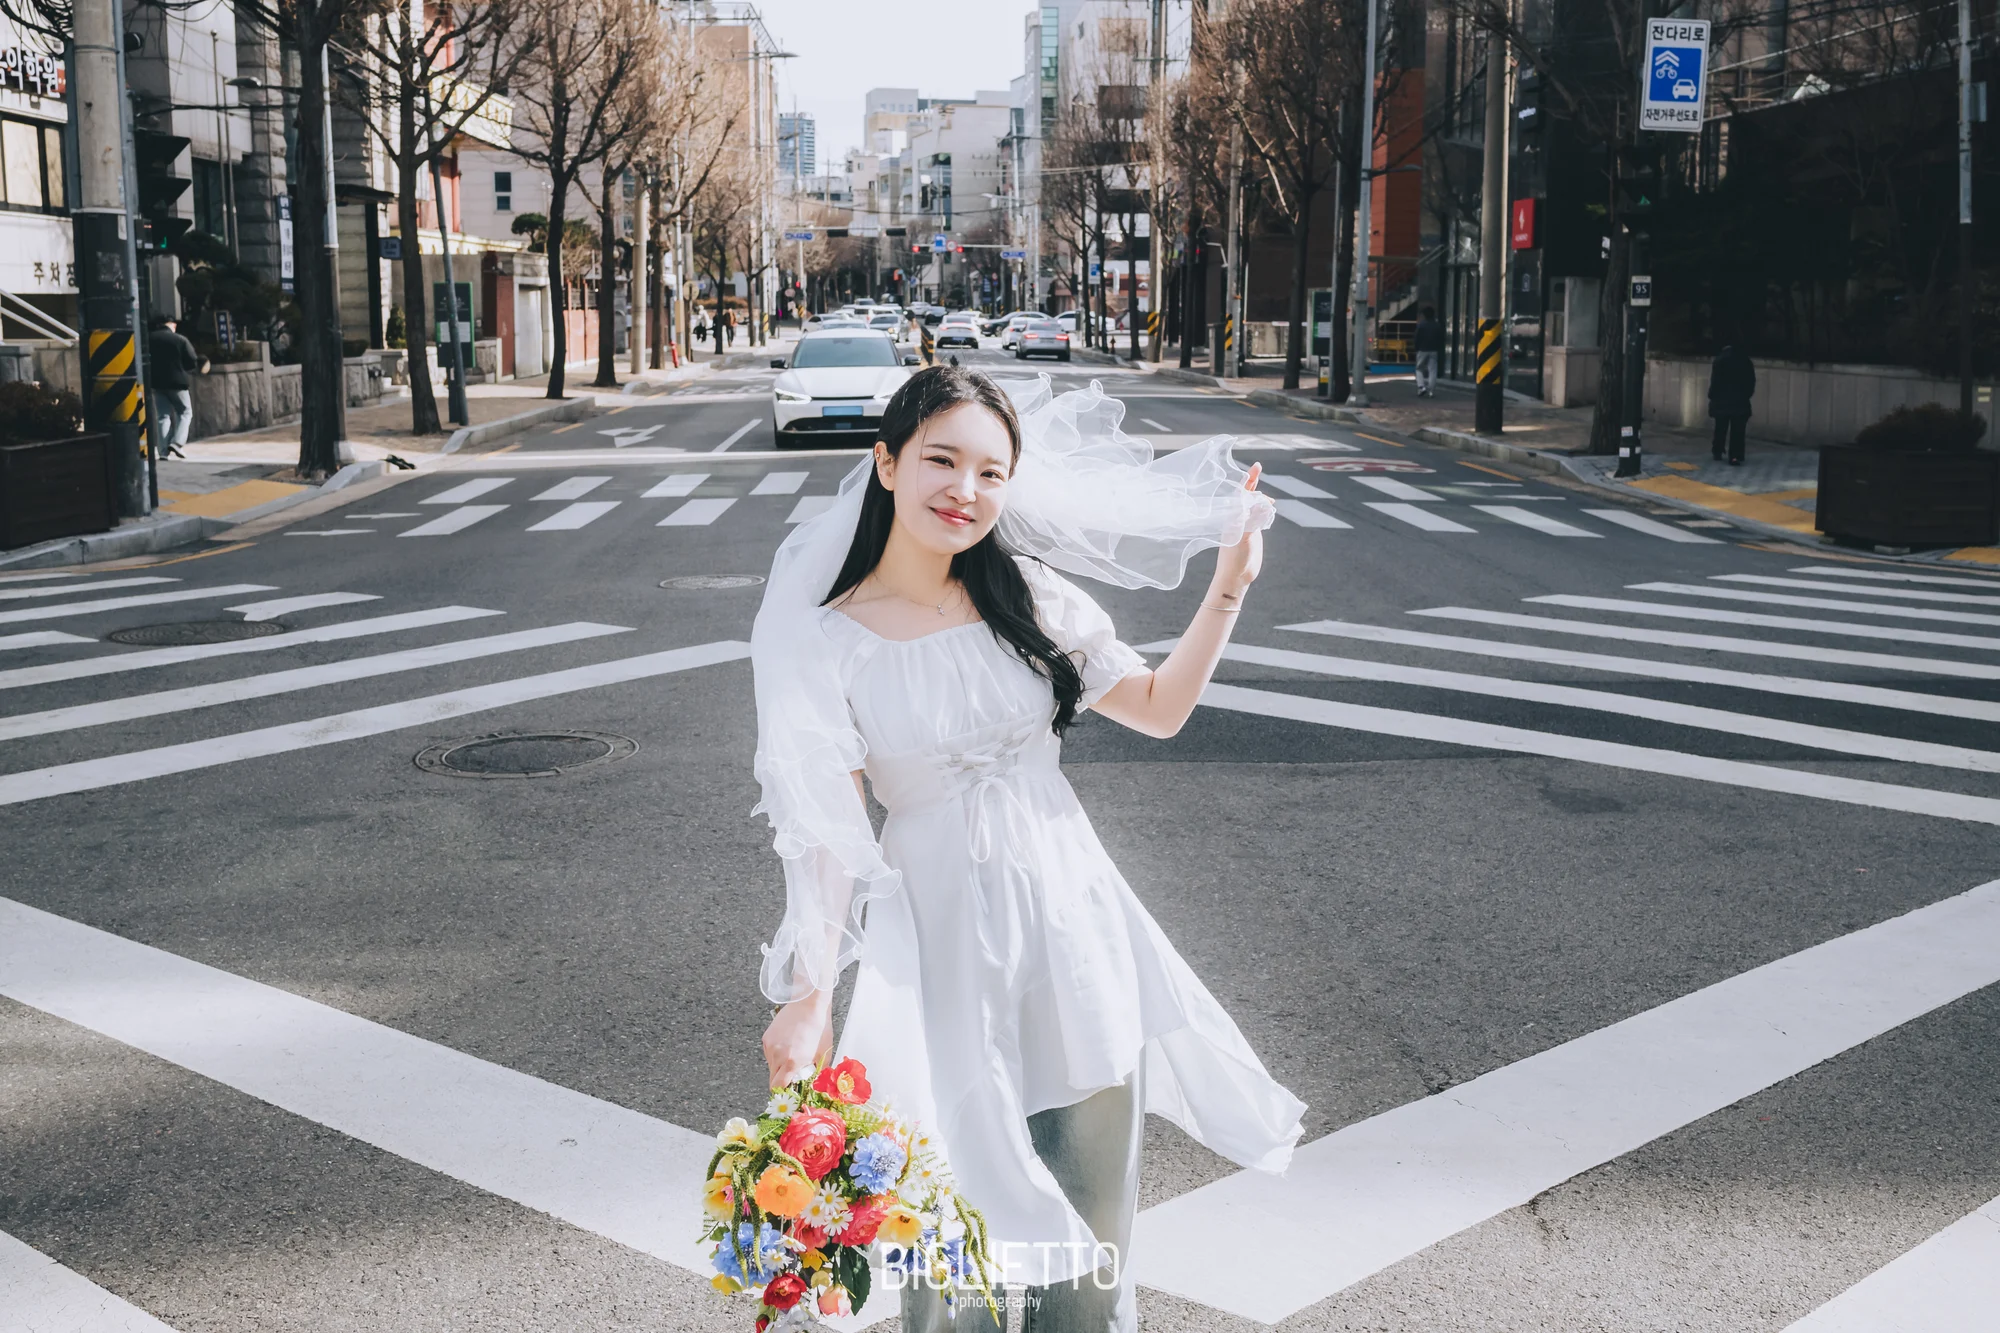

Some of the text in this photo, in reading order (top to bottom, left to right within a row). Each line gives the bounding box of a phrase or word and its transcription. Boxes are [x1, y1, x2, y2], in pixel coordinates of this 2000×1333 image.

[1652, 25, 1705, 41] 잔다리로
[1645, 108, 1699, 122] 자전거우선도로
[1635, 284, 1648, 294] 95
